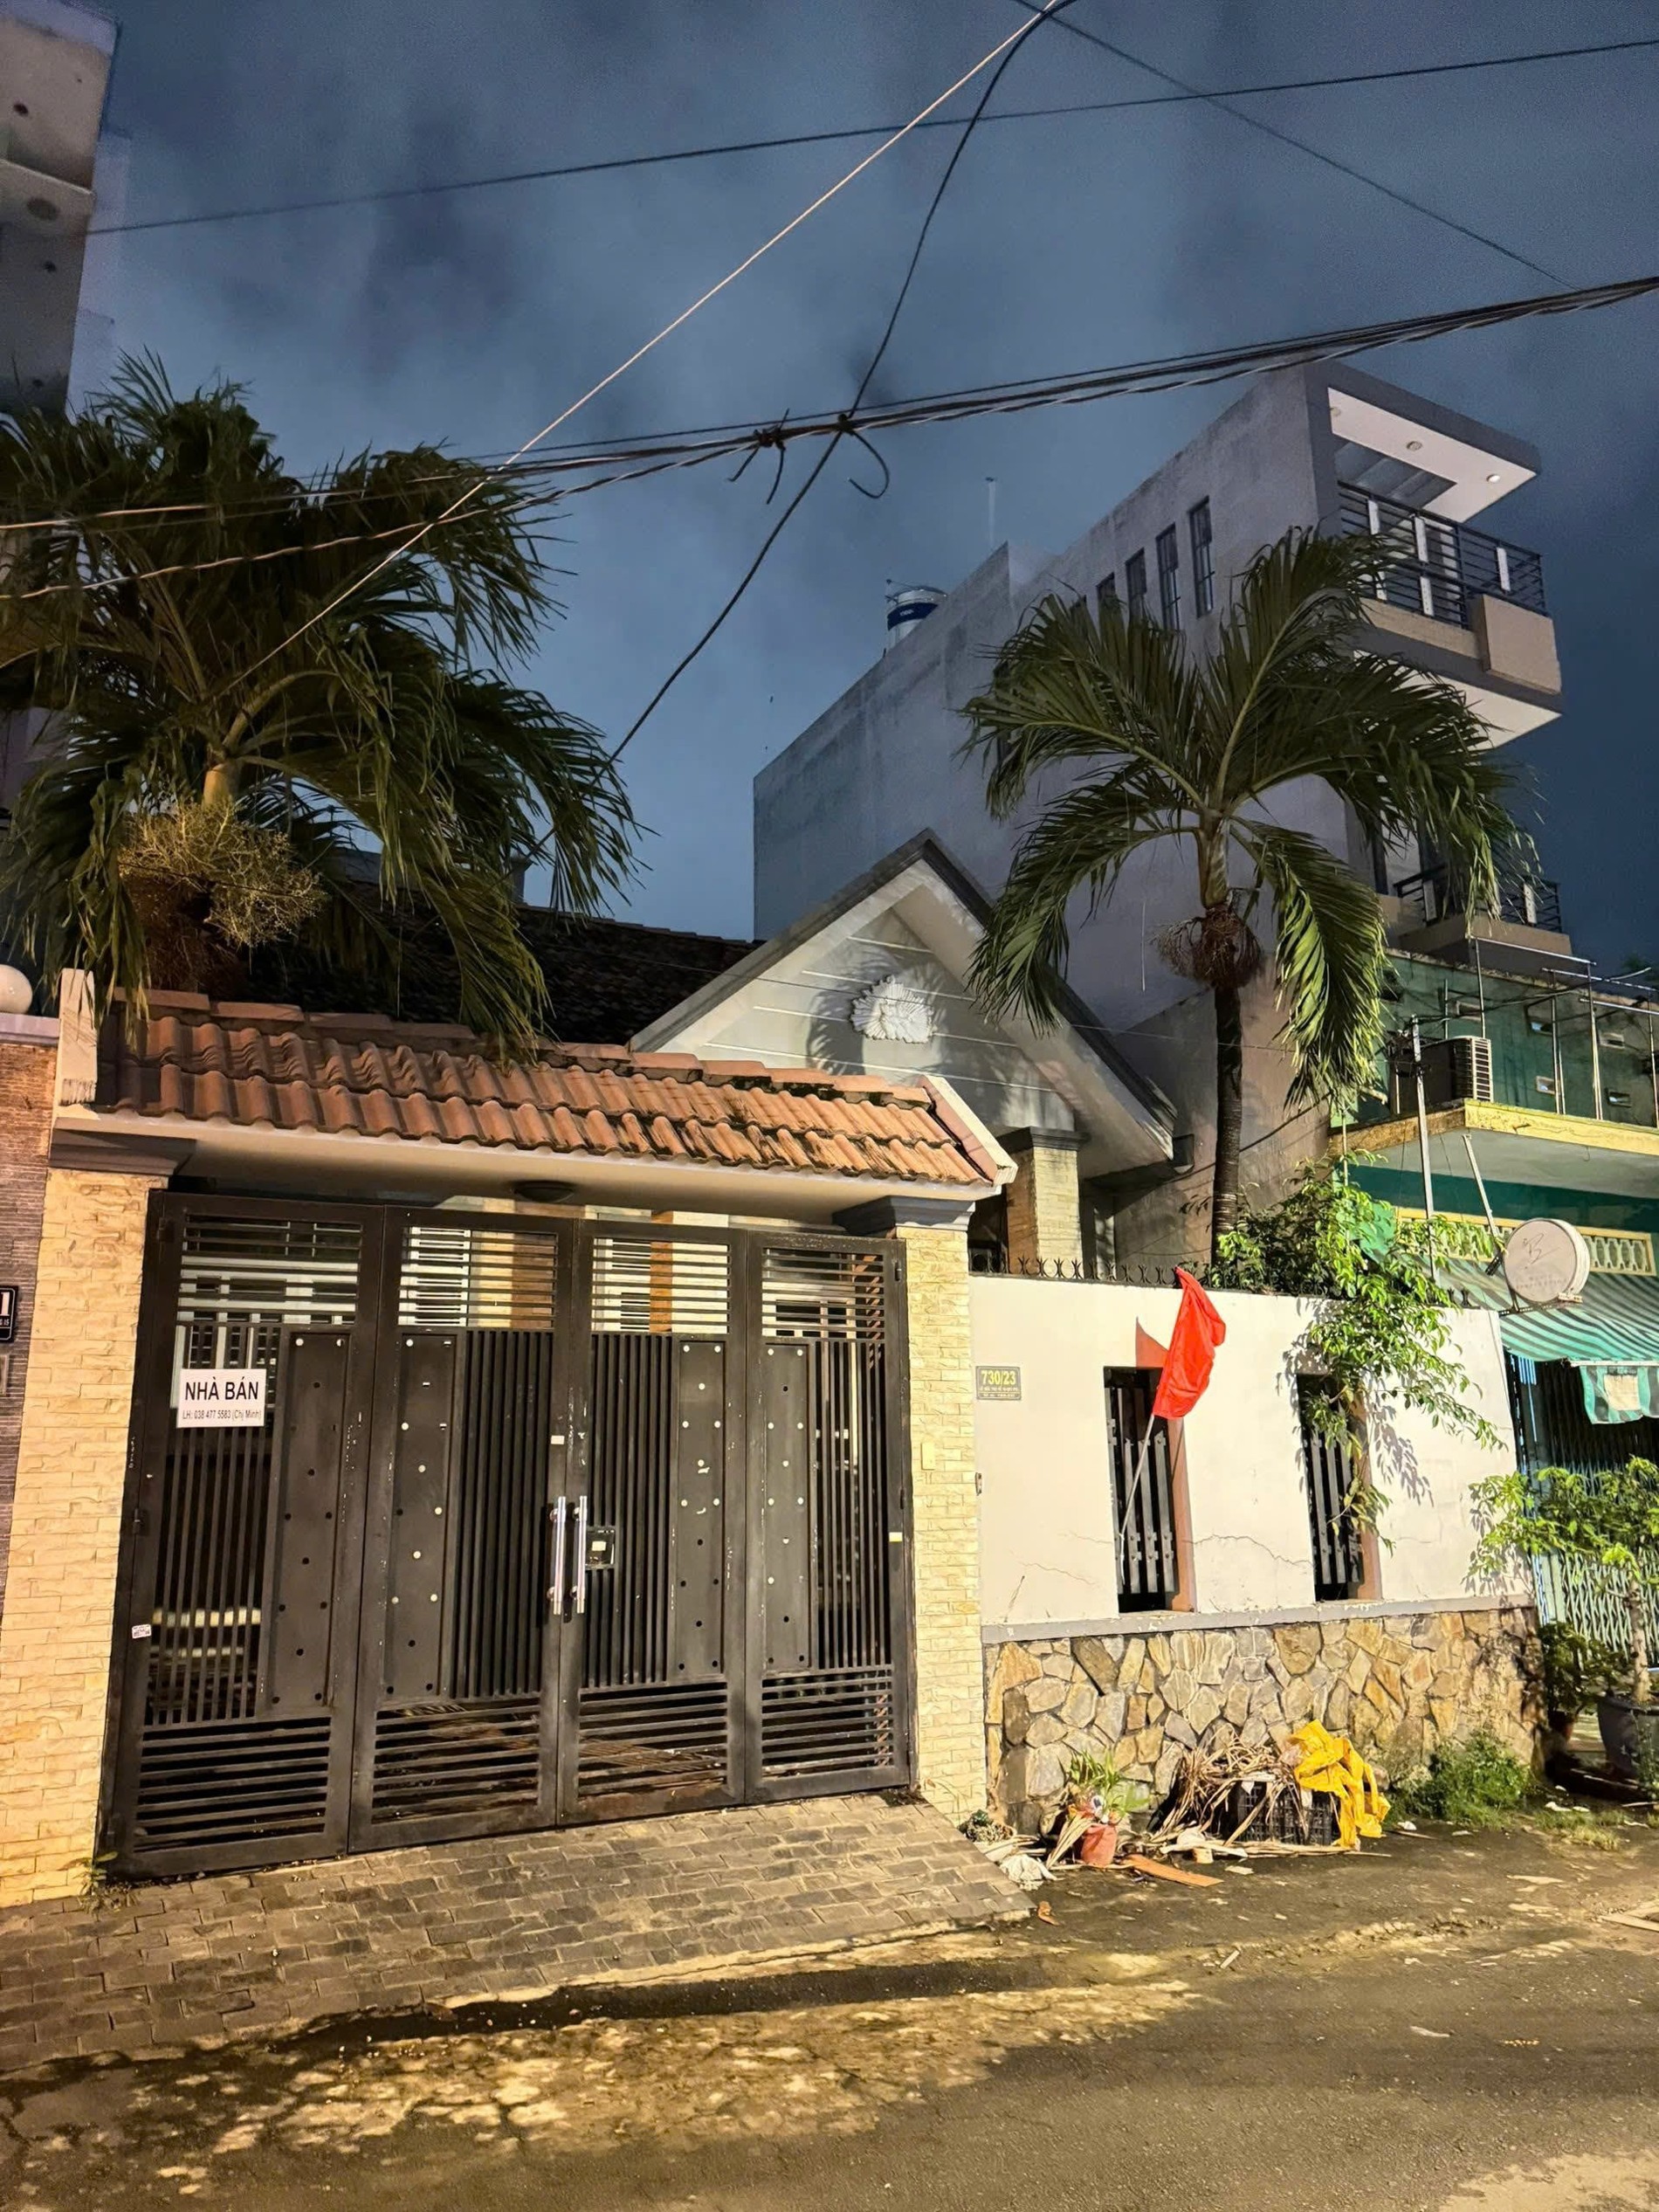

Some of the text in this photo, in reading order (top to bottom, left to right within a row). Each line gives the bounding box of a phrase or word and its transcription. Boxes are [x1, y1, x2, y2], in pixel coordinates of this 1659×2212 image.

[981, 1369, 1015, 1386] 730/23
[185, 1376, 258, 1401] NHÀ BÁN
[194, 1409, 205, 1419] 038
[205, 1409, 217, 1419] 477
